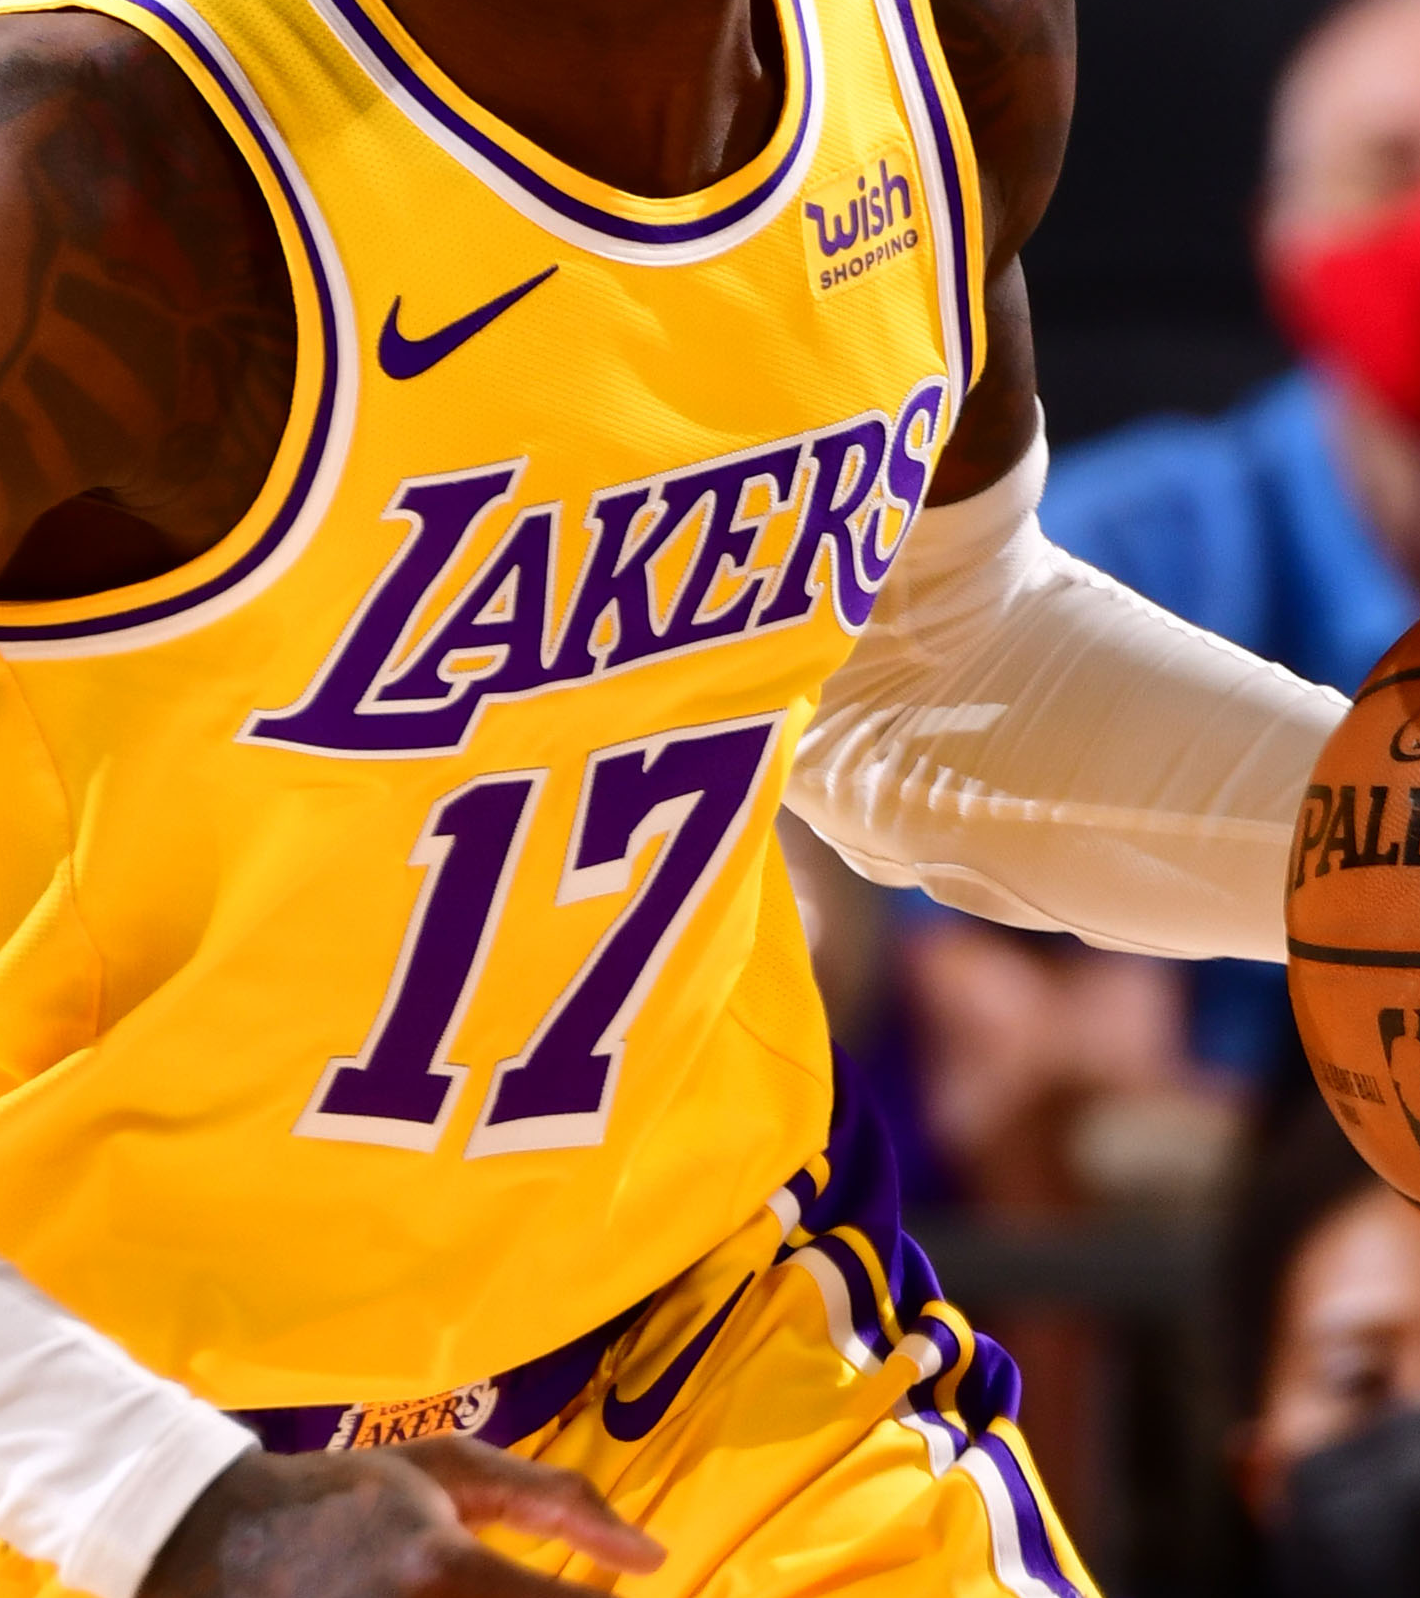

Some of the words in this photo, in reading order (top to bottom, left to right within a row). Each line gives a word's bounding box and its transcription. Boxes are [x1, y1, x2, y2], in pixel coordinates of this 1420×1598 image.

[805, 159, 912, 256] wish
[820, 229, 918, 290] SHOPPING
[234, 375, 950, 760] LAKERS
[291, 708, 788, 1159] 17
